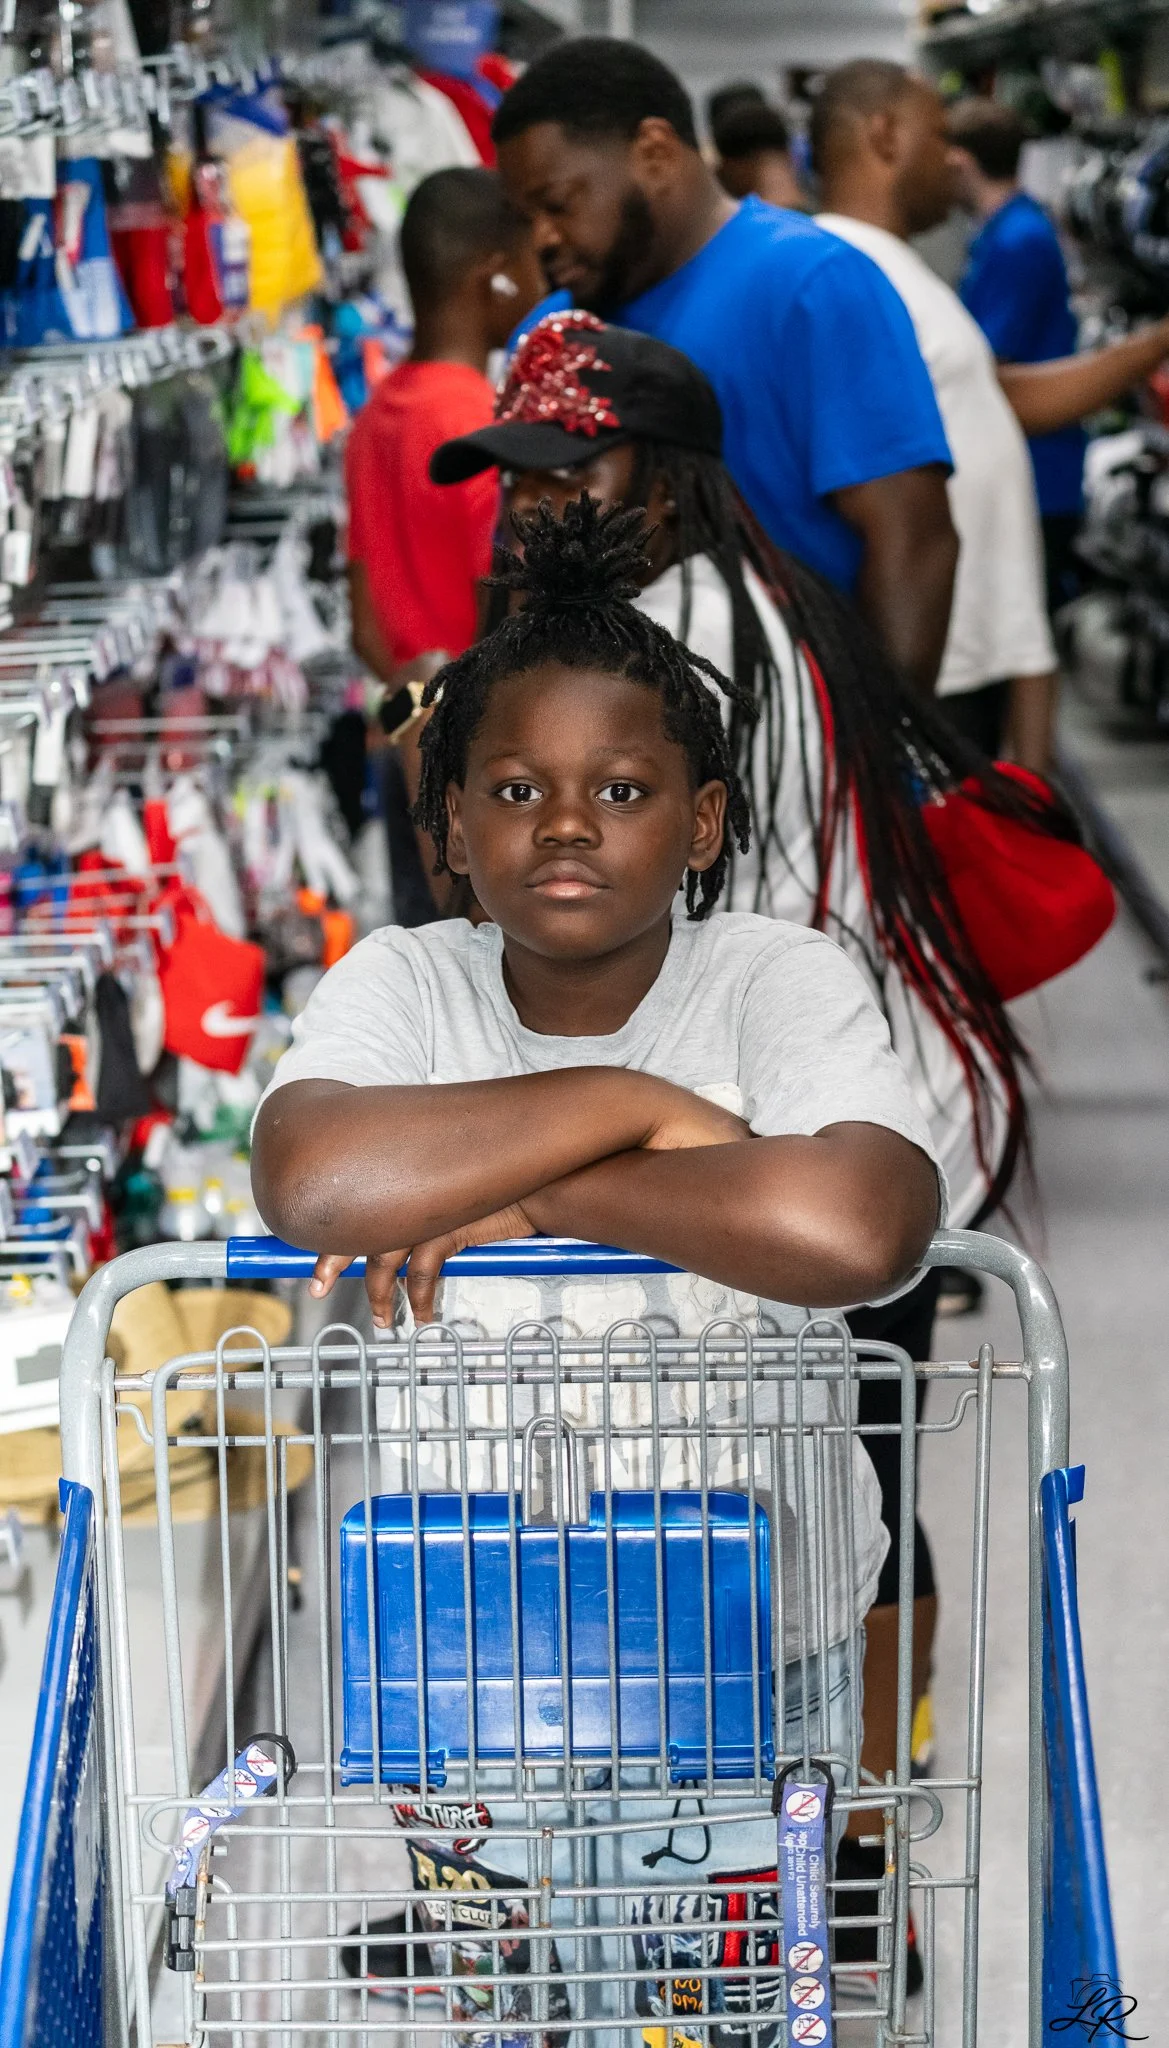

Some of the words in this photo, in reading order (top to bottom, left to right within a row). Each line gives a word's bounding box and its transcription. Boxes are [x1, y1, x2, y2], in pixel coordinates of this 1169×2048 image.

[795, 1845, 807, 1873] Child
[809, 1854, 820, 1881] Child
[796, 1875, 808, 1936] Unattended
[808, 1884, 821, 1929] Securely
